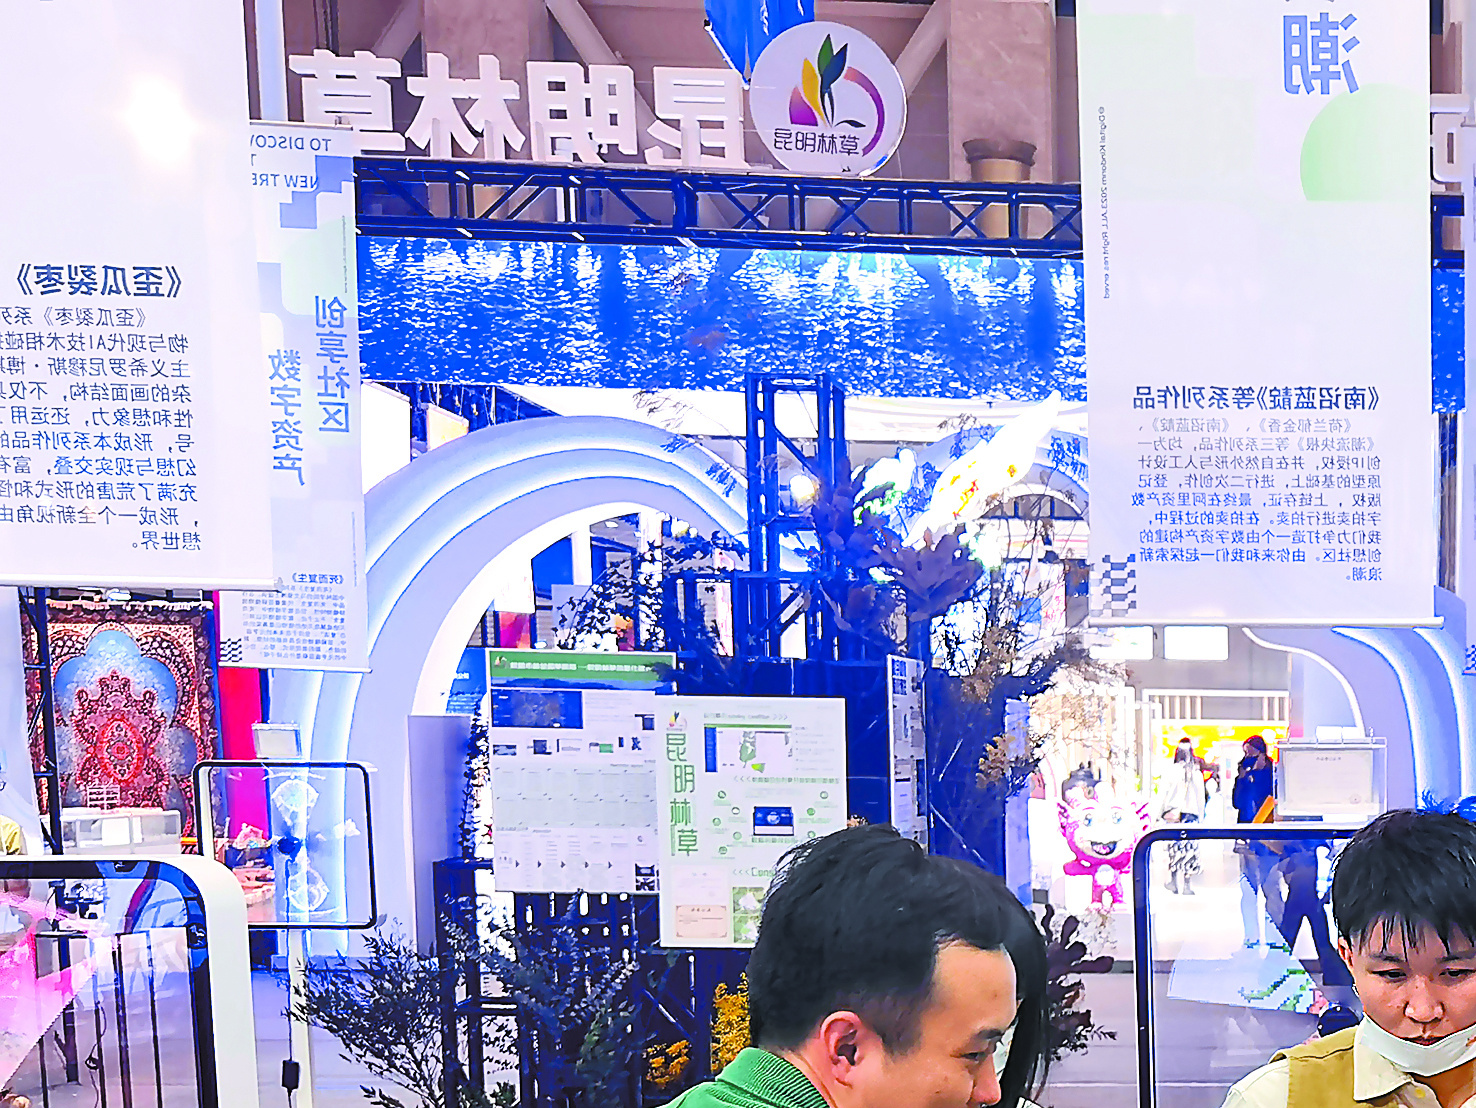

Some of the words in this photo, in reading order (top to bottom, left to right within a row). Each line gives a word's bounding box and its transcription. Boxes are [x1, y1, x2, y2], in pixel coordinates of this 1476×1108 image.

[773, 128, 861, 156] 昆明林草
[666, 732, 698, 856] 昆明林草
